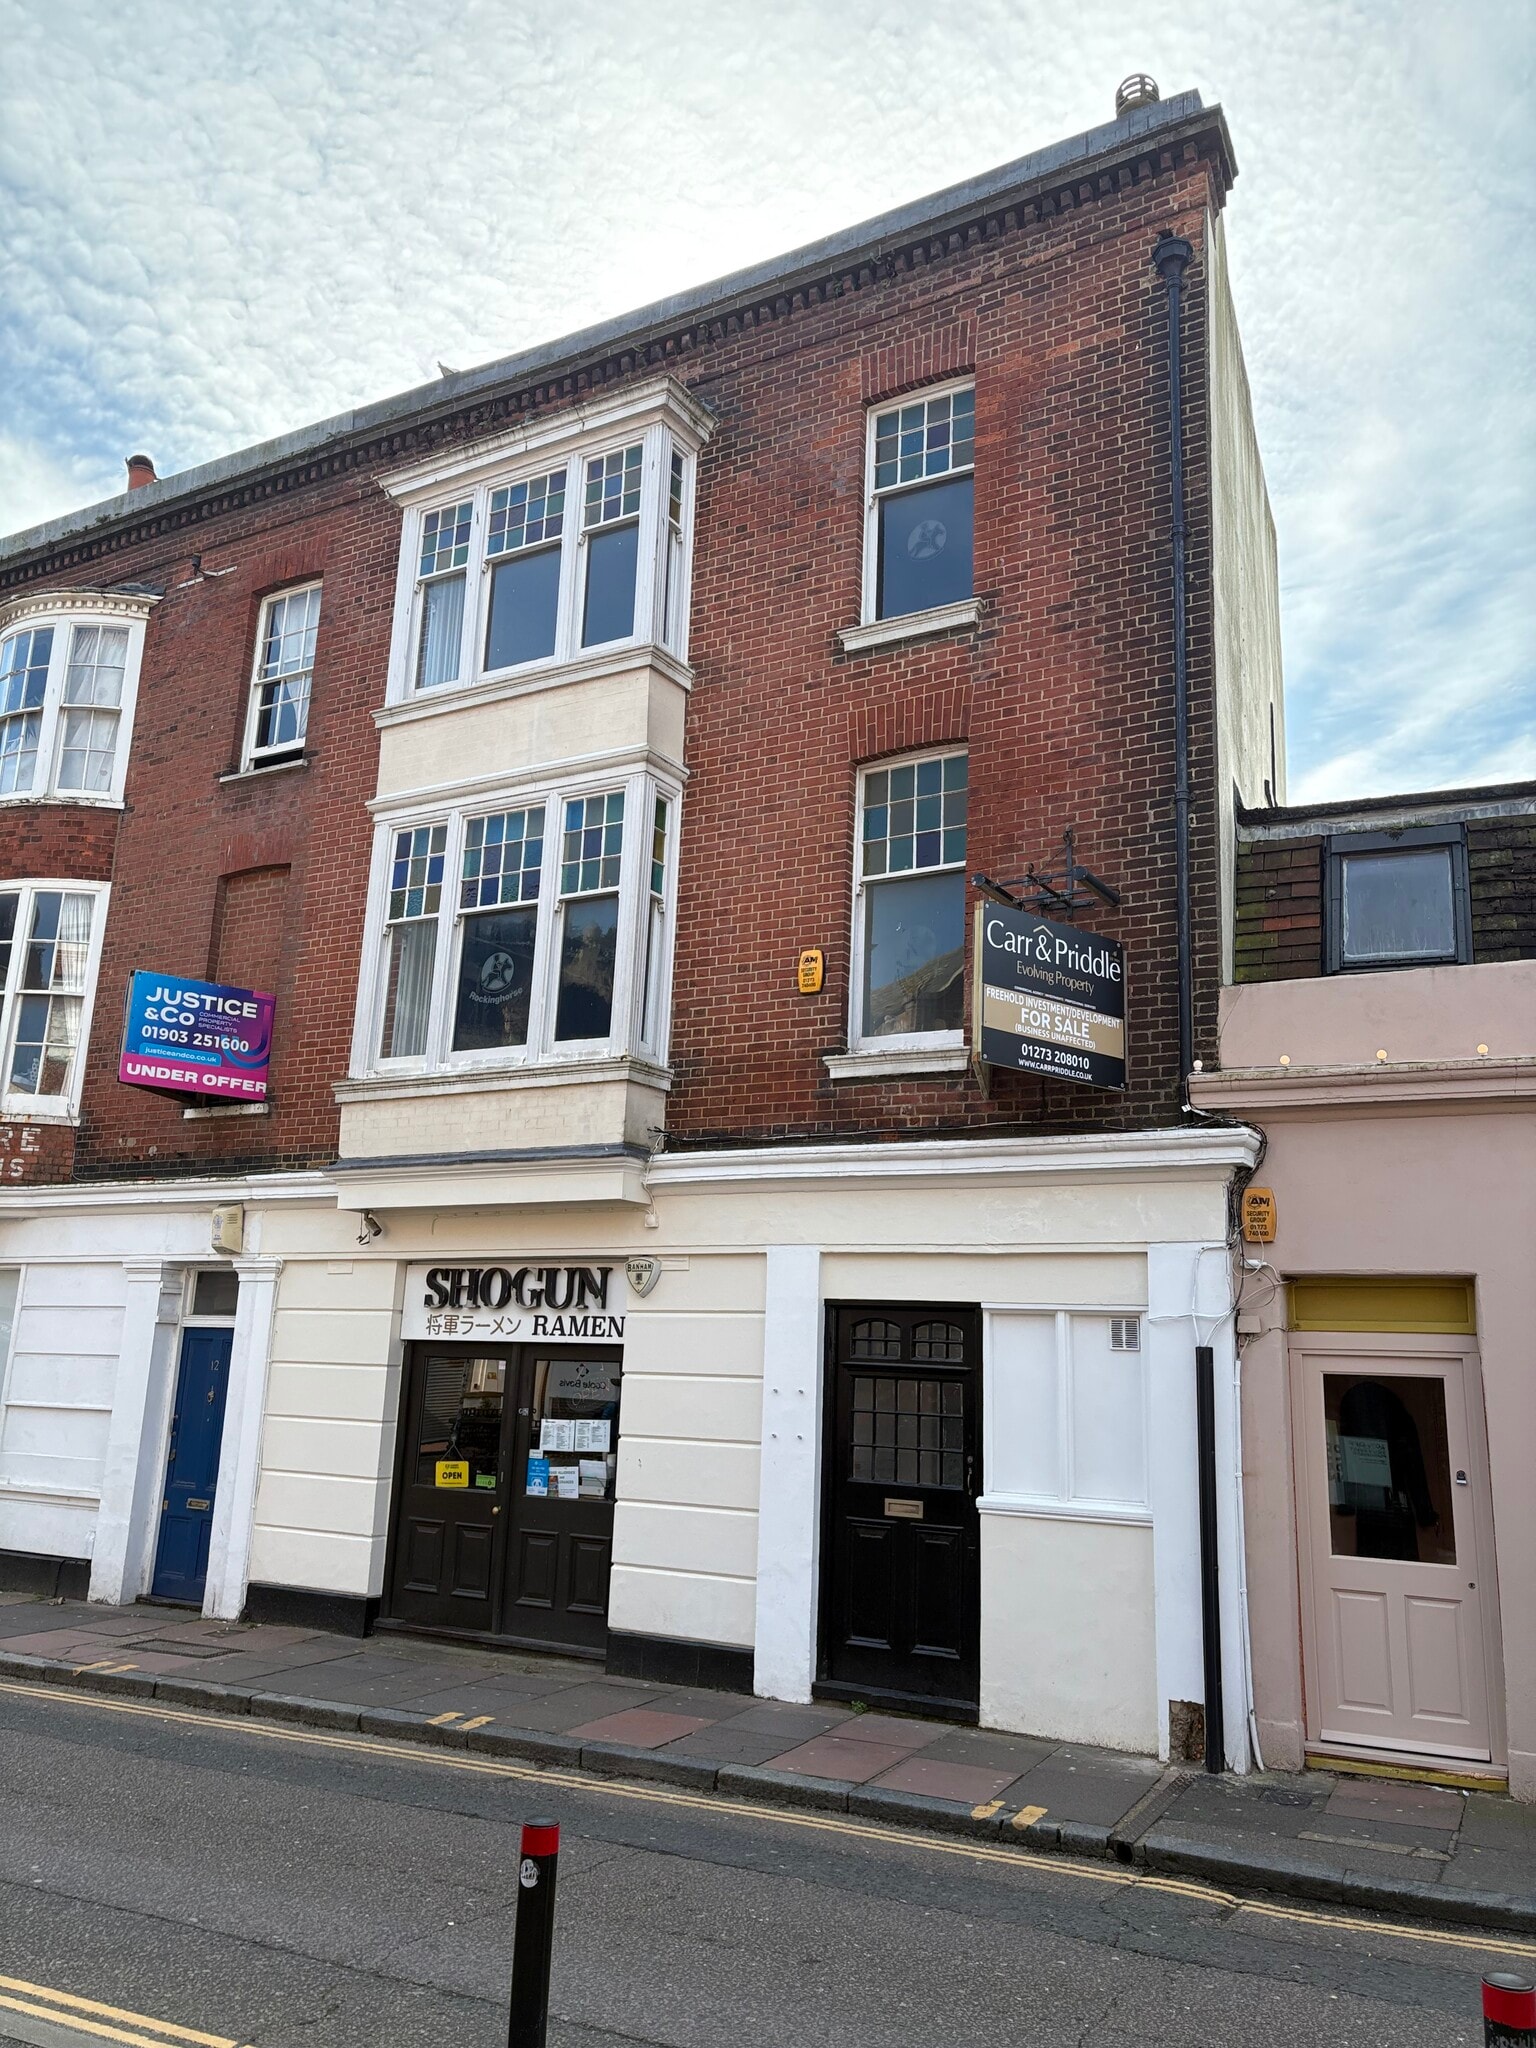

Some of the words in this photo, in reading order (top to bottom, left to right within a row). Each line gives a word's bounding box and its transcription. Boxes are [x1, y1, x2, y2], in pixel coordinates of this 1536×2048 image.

[987, 920, 1033, 957] Carr
[1036, 934, 1052, 963] &
[1055, 938, 1121, 982] Priddle
[1016, 960, 1055, 985] Evolving
[1055, 970, 1095, 996] Property
[146, 987, 258, 1018] JUSTICE
[469, 987, 523, 1004] Rockinghorse
[986, 987, 1024, 1005] FREEHOLD
[1025, 996, 1120, 1029] INVESTMENT/DEVELOPMENT
[198, 1017, 233, 1027] PROPERTY
[198, 1022, 238, 1034] SPECIALISTS
[199, 1011, 241, 1023] COMMERCIAL
[1021, 1008, 1051, 1030] FOR
[1054, 1017, 1090, 1039] SALE
[142, 1025, 188, 1043] 01903
[193, 1033, 249, 1053] 251600
[1015, 1023, 1050, 1039] (BUSINESS
[1051, 1031, 1096, 1050] UNAFFECTED)
[144, 1047, 217, 1063] justiceandco.co.uk
[1021, 1043, 1052, 1061] 01273
[1054, 1051, 1090, 1070] 208010
[126, 1063, 198, 1083] UNDER
[202, 1074, 267, 1093] OFFER
[1018, 1058, 1093, 1081] WWW.CARRPRIDDLE.CO.UK
[424, 1267, 614, 1310] SHOGUN
[426, 1314, 522, 1336] 将軍ラーメン
[532, 1315, 626, 1338] RAMEN
[210, 1360, 220, 1370] 12
